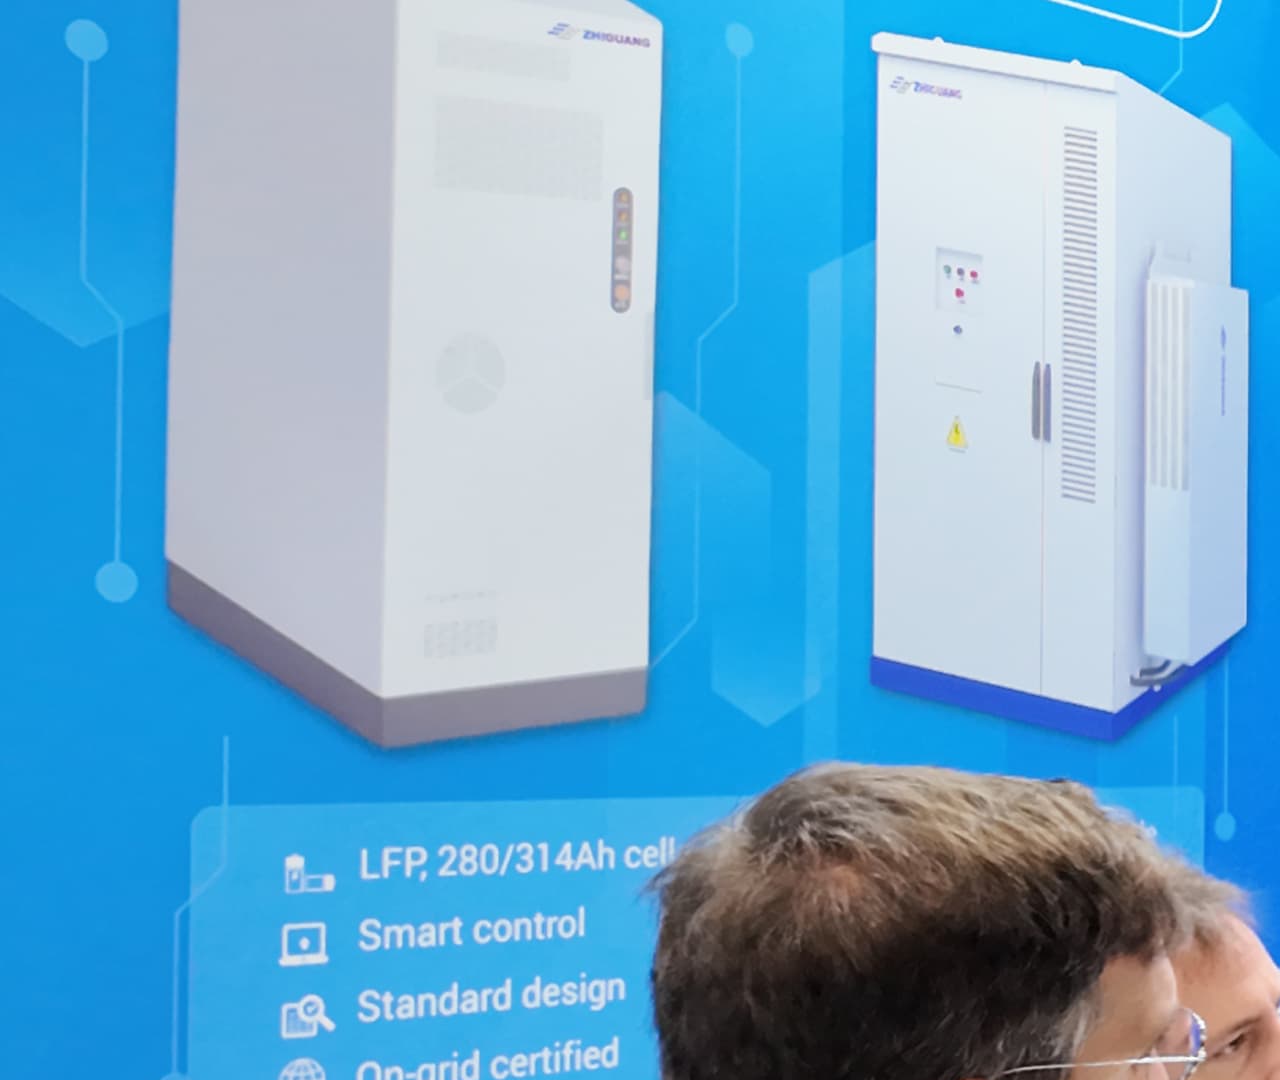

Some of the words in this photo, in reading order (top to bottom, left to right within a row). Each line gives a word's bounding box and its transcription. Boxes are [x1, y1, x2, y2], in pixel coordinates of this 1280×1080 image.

[360, 846, 428, 882] LFP,
[437, 838, 616, 878] 280/314Ah
[358, 916, 463, 952] Smart
[472, 906, 586, 944] control
[357, 977, 512, 1023] Standard
[522, 972, 626, 1011] design
[490, 1035, 619, 1080] certified
